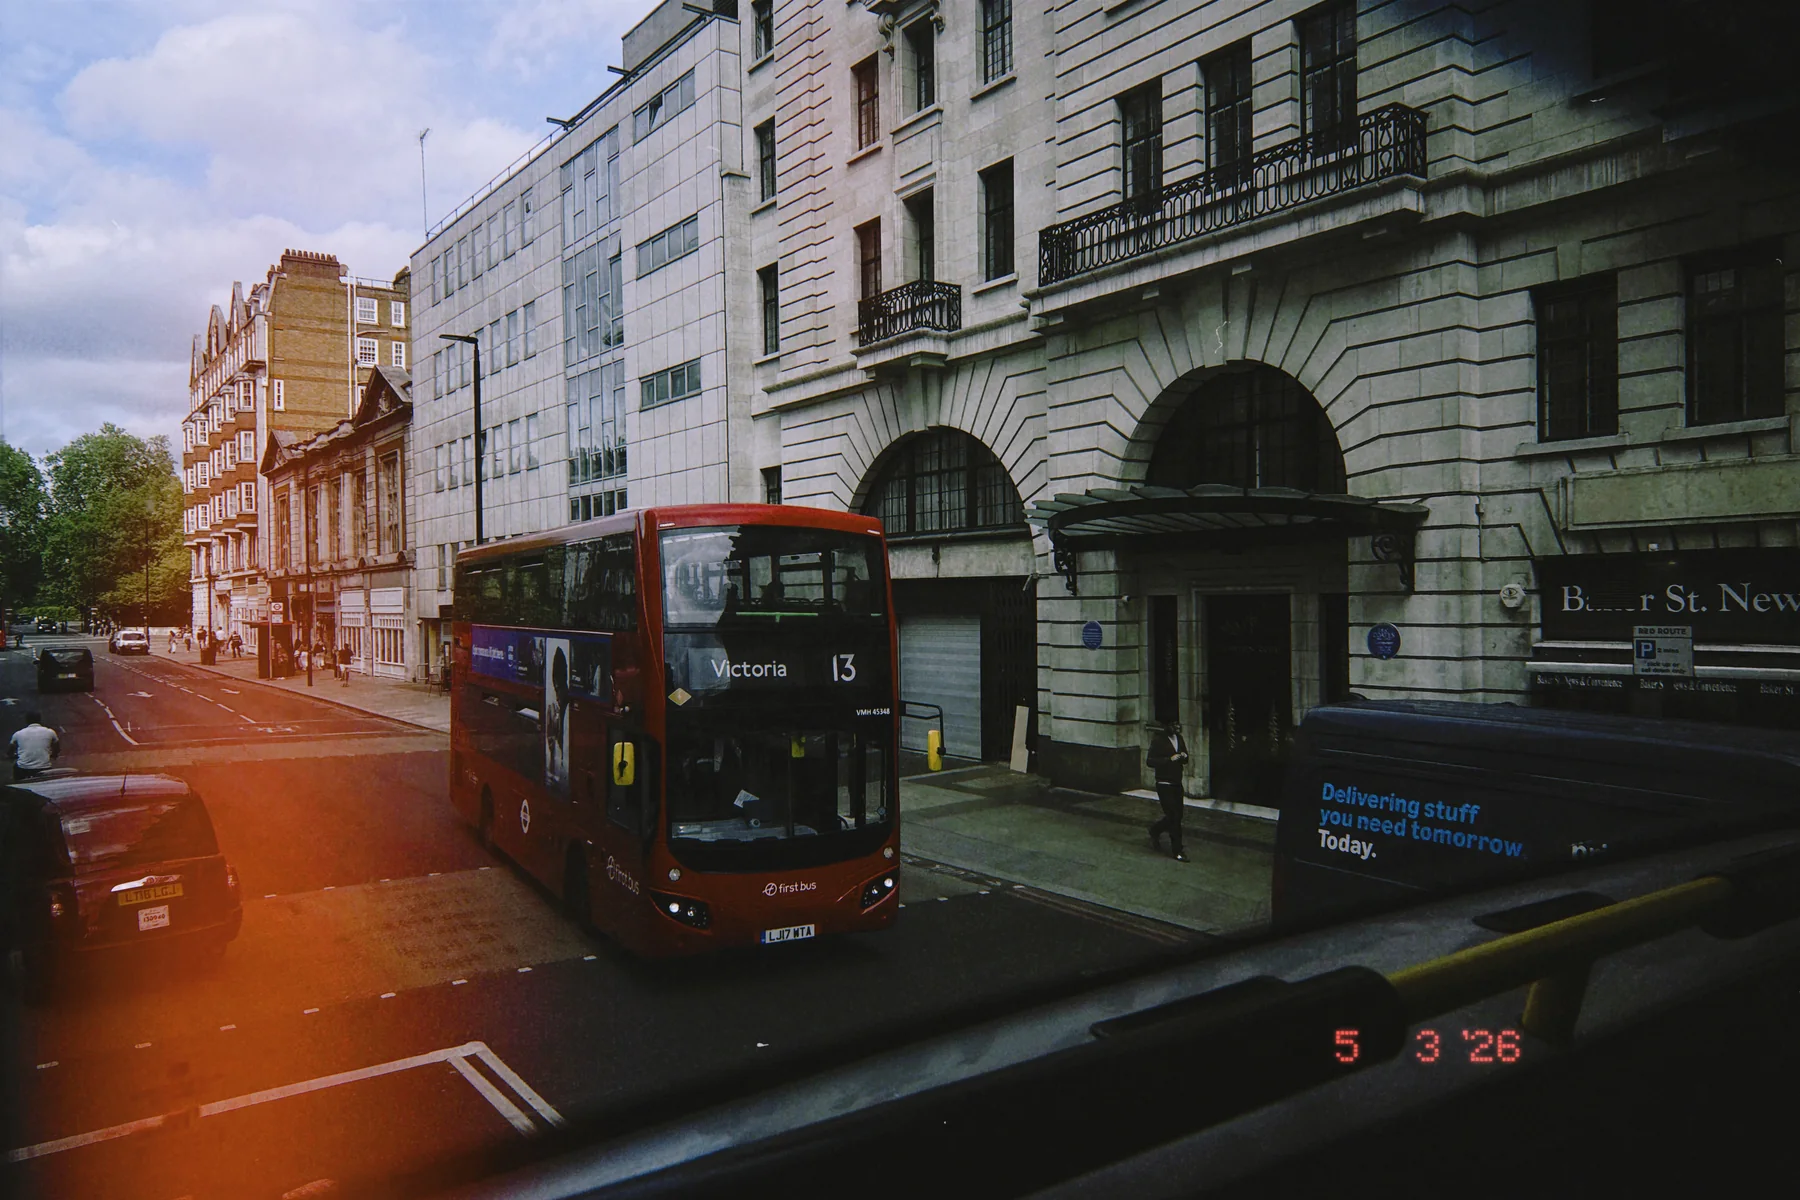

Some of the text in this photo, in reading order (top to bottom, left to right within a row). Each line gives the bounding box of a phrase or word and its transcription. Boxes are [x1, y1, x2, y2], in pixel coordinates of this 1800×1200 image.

[1666, 584, 1708, 612] St.
[711, 653, 857, 682] Victoria 13
[872, 708, 891, 716] 45348
[1321, 781, 1481, 825] Delivering stuff
[1318, 808, 1353, 827] you
[1356, 814, 1407, 837] need
[1317, 828, 1377, 860] Today.
[779, 880, 817, 893] first bus
[769, 926, 811, 941] LJ17 WTA
